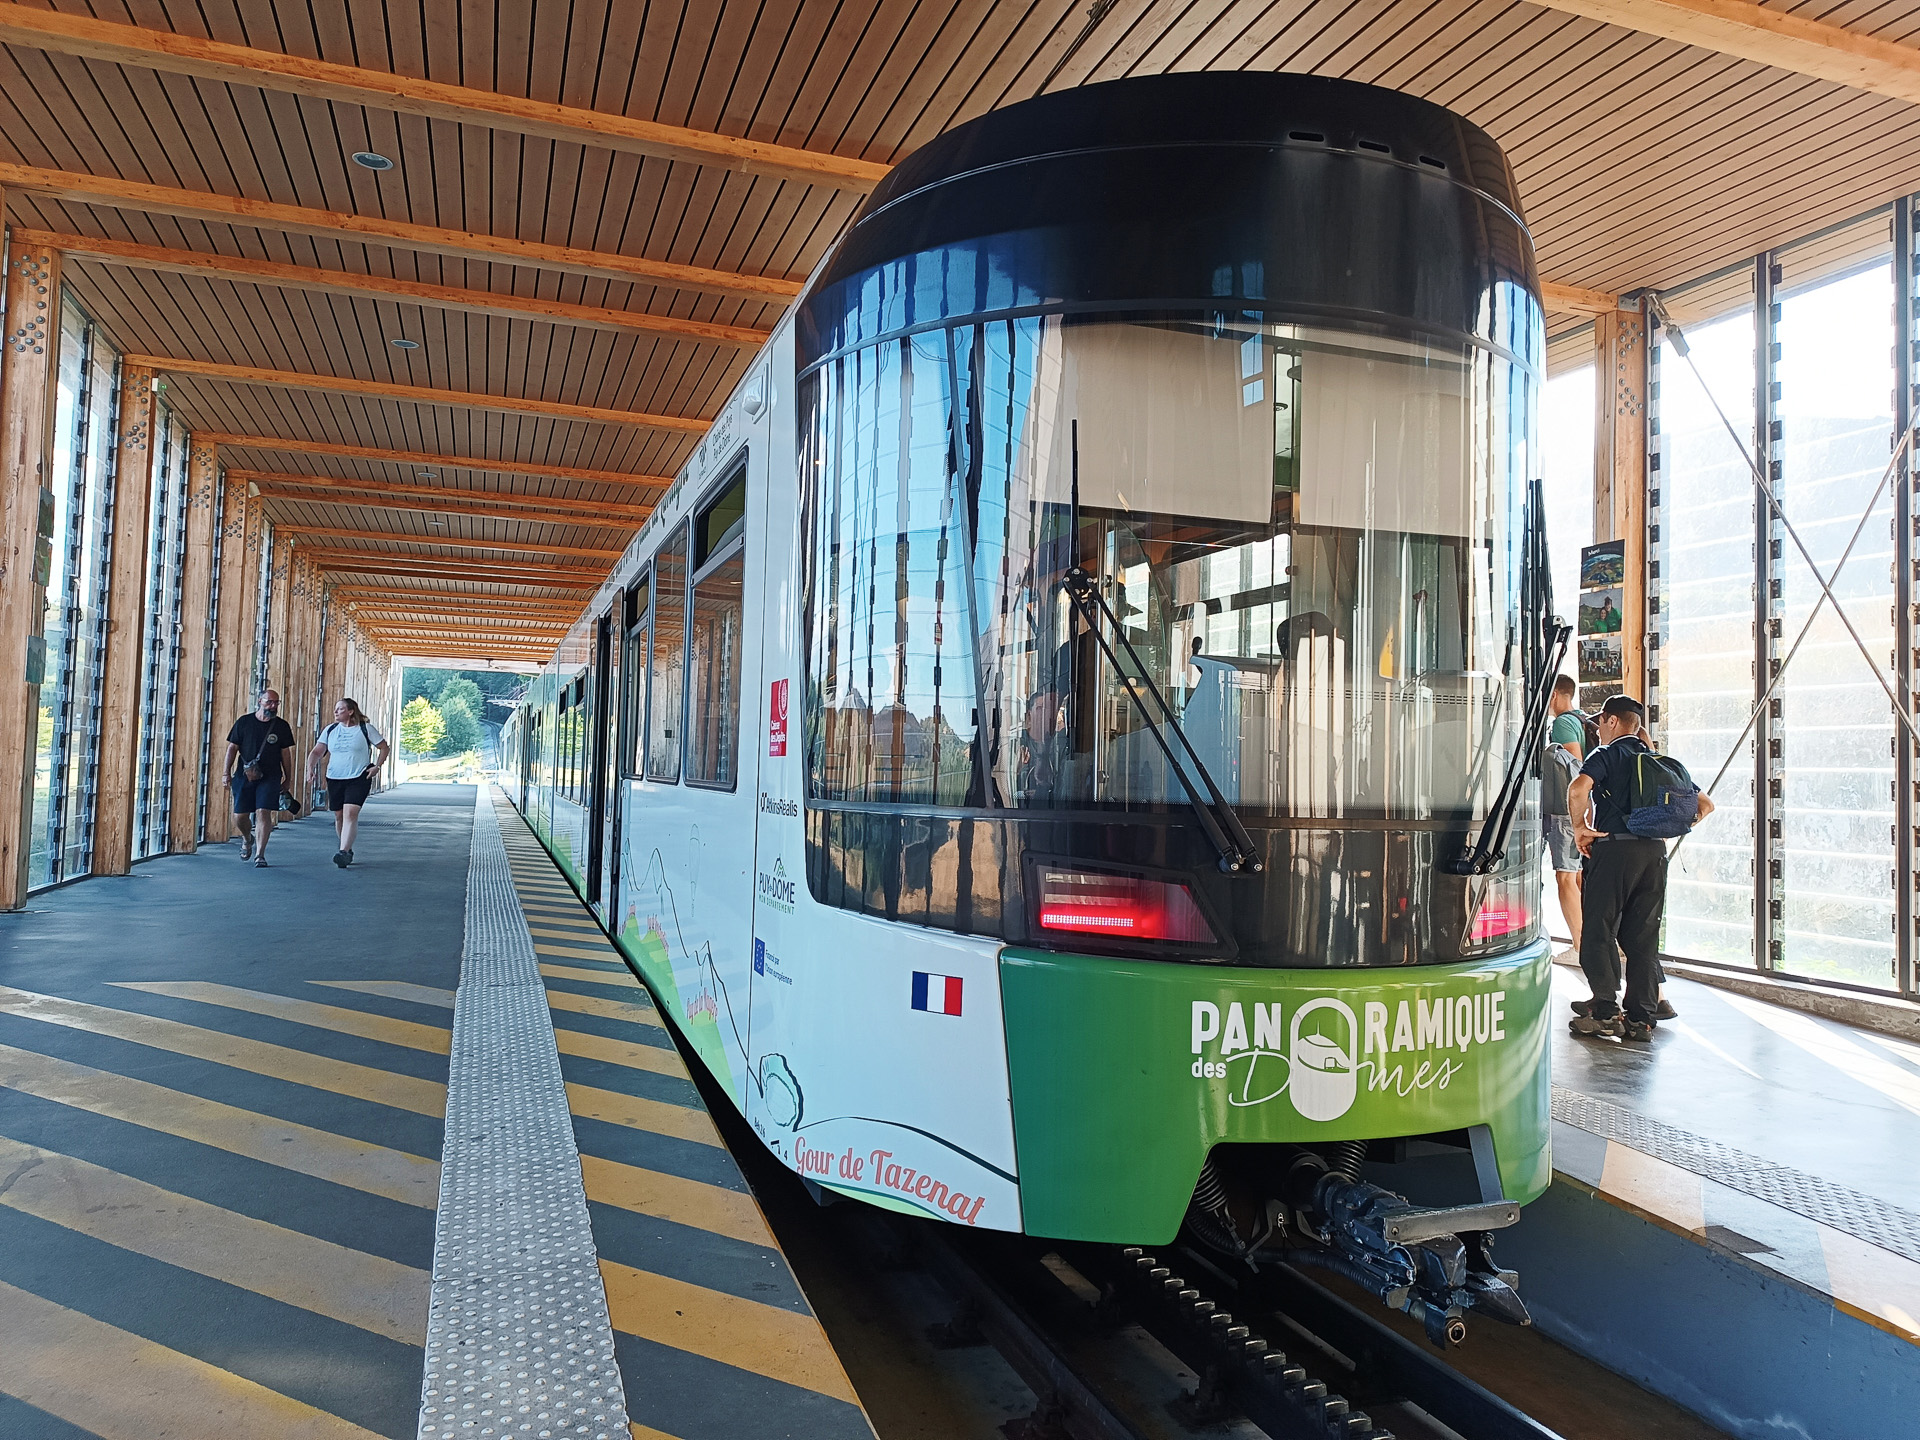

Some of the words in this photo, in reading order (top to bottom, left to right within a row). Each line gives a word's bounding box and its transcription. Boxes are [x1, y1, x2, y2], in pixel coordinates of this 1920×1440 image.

[1191, 1057, 1227, 1079] des
[794, 1136, 835, 1177] Gour
[838, 1147, 864, 1182] de
[869, 1149, 986, 1226] Tazenat
